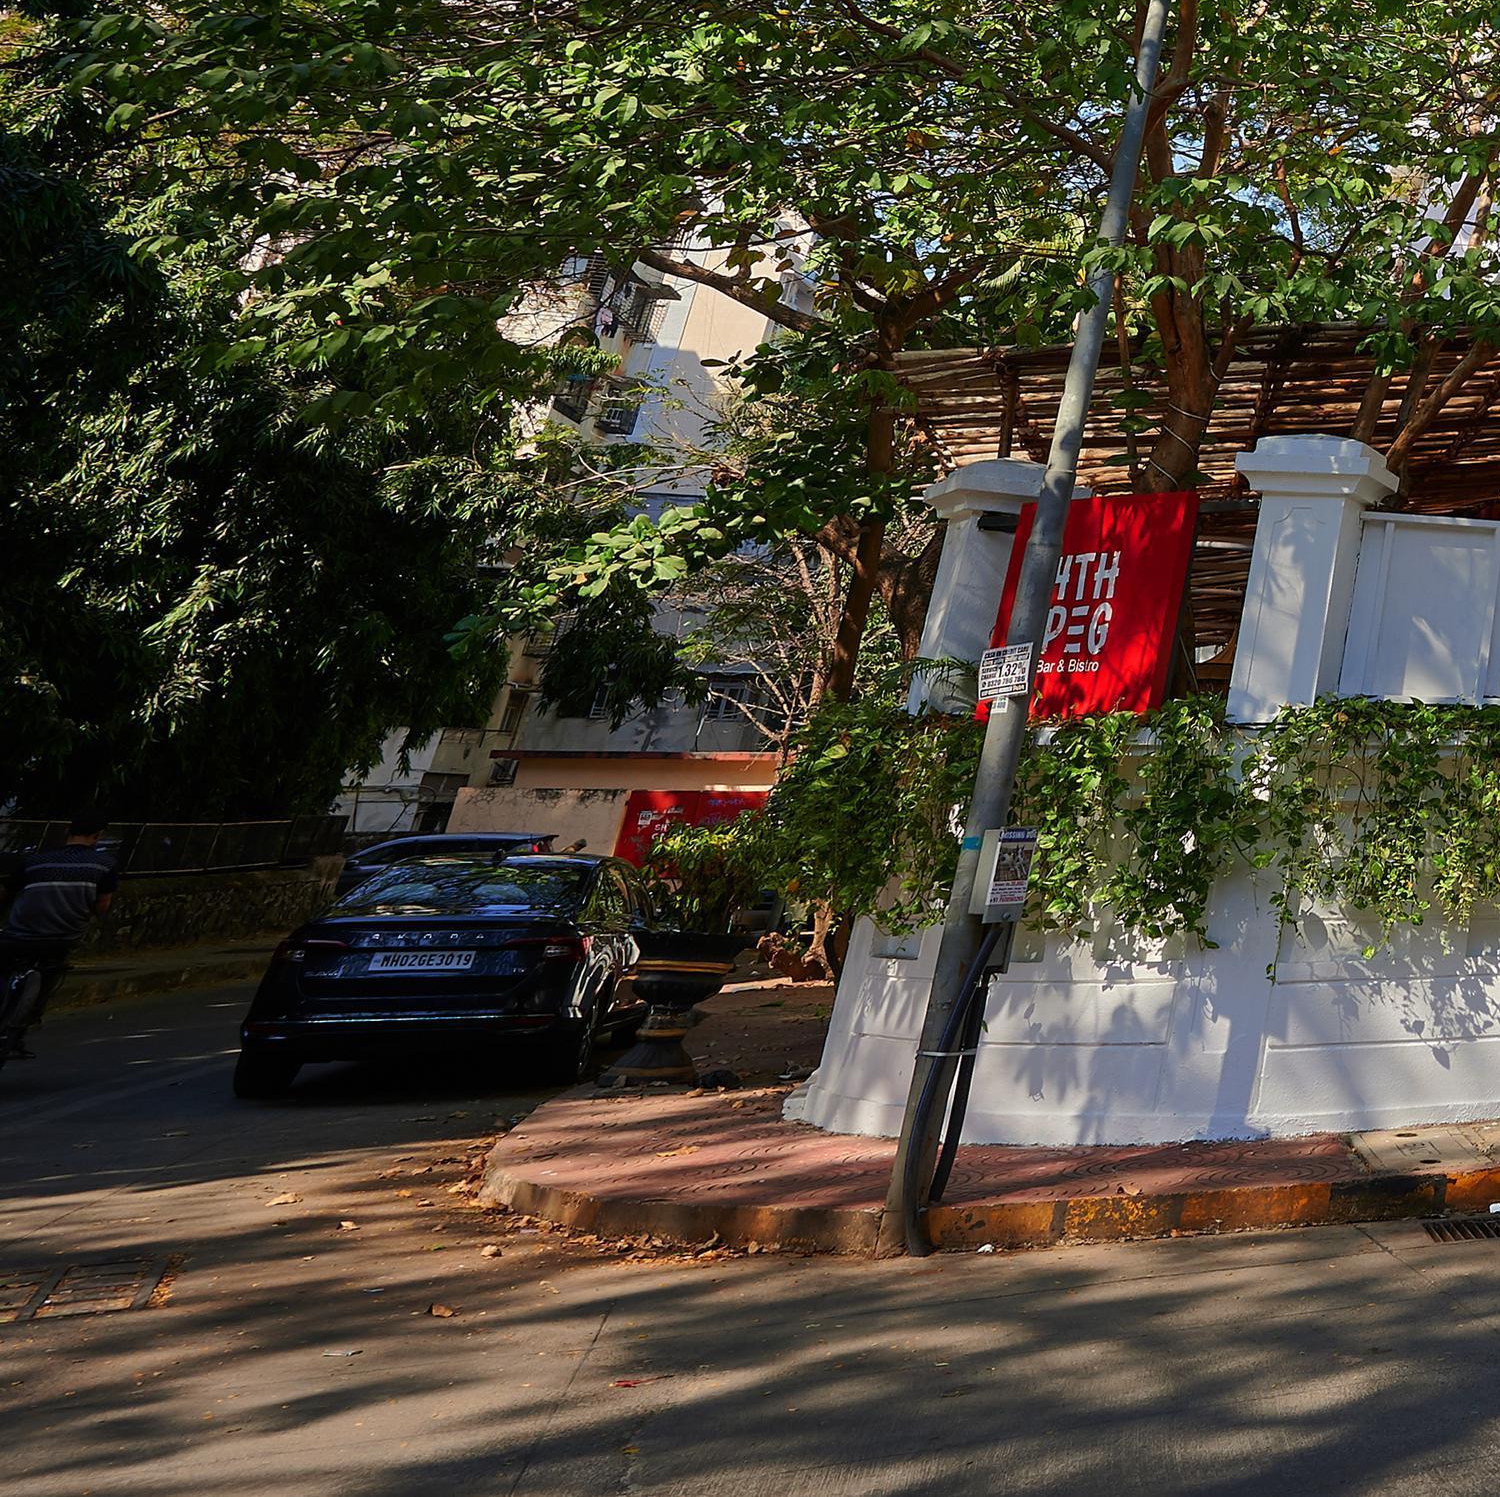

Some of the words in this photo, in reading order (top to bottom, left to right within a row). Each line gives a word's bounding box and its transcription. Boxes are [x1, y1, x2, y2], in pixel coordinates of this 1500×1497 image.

[1055, 551, 1121, 600] 4TH
[1040, 602, 1113, 655] PEG
[1036, 659, 1055, 674] Bar
[1056, 659, 1065, 672] &
[1067, 658, 1099, 673] Bistro
[380, 953, 472, 967] MH02GE3019
